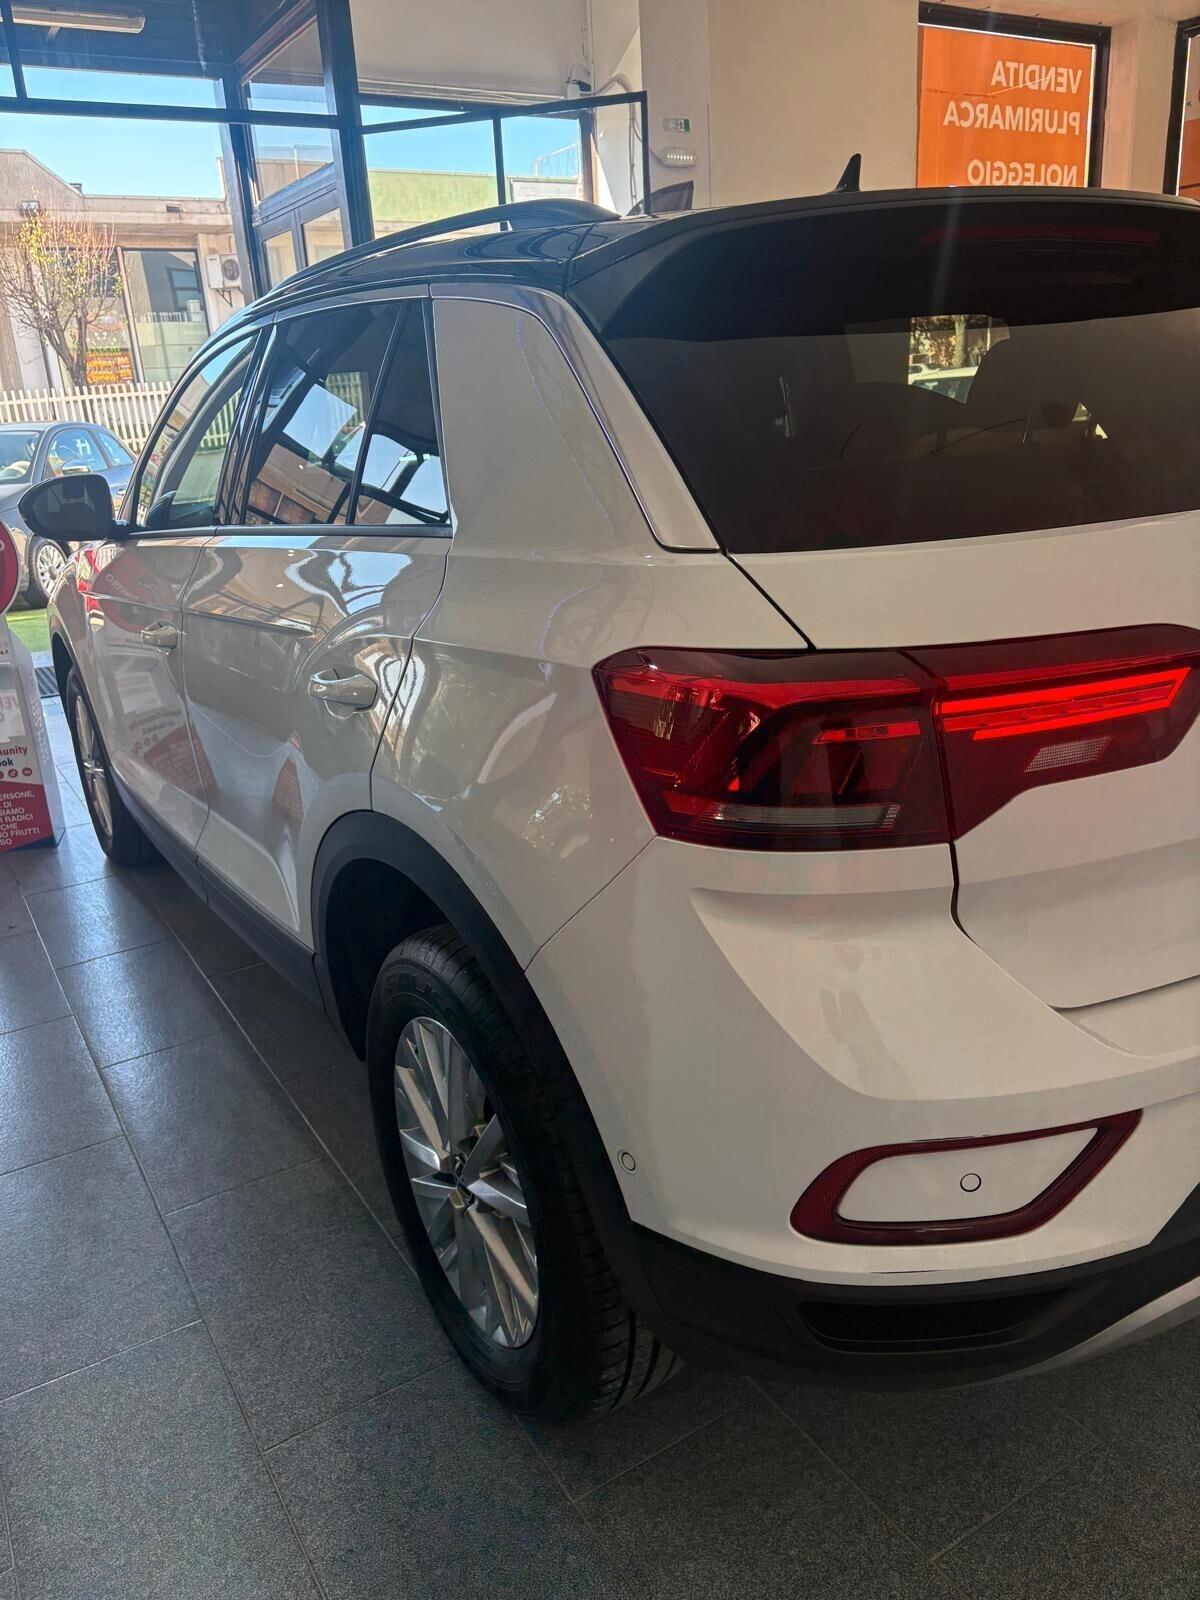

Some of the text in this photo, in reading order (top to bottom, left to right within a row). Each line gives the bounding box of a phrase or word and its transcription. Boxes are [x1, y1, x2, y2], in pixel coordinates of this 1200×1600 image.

[4, 813, 34, 822] RADICI
[0, 822, 18, 831] CHE
[10, 827, 40, 838] FRUTTI
